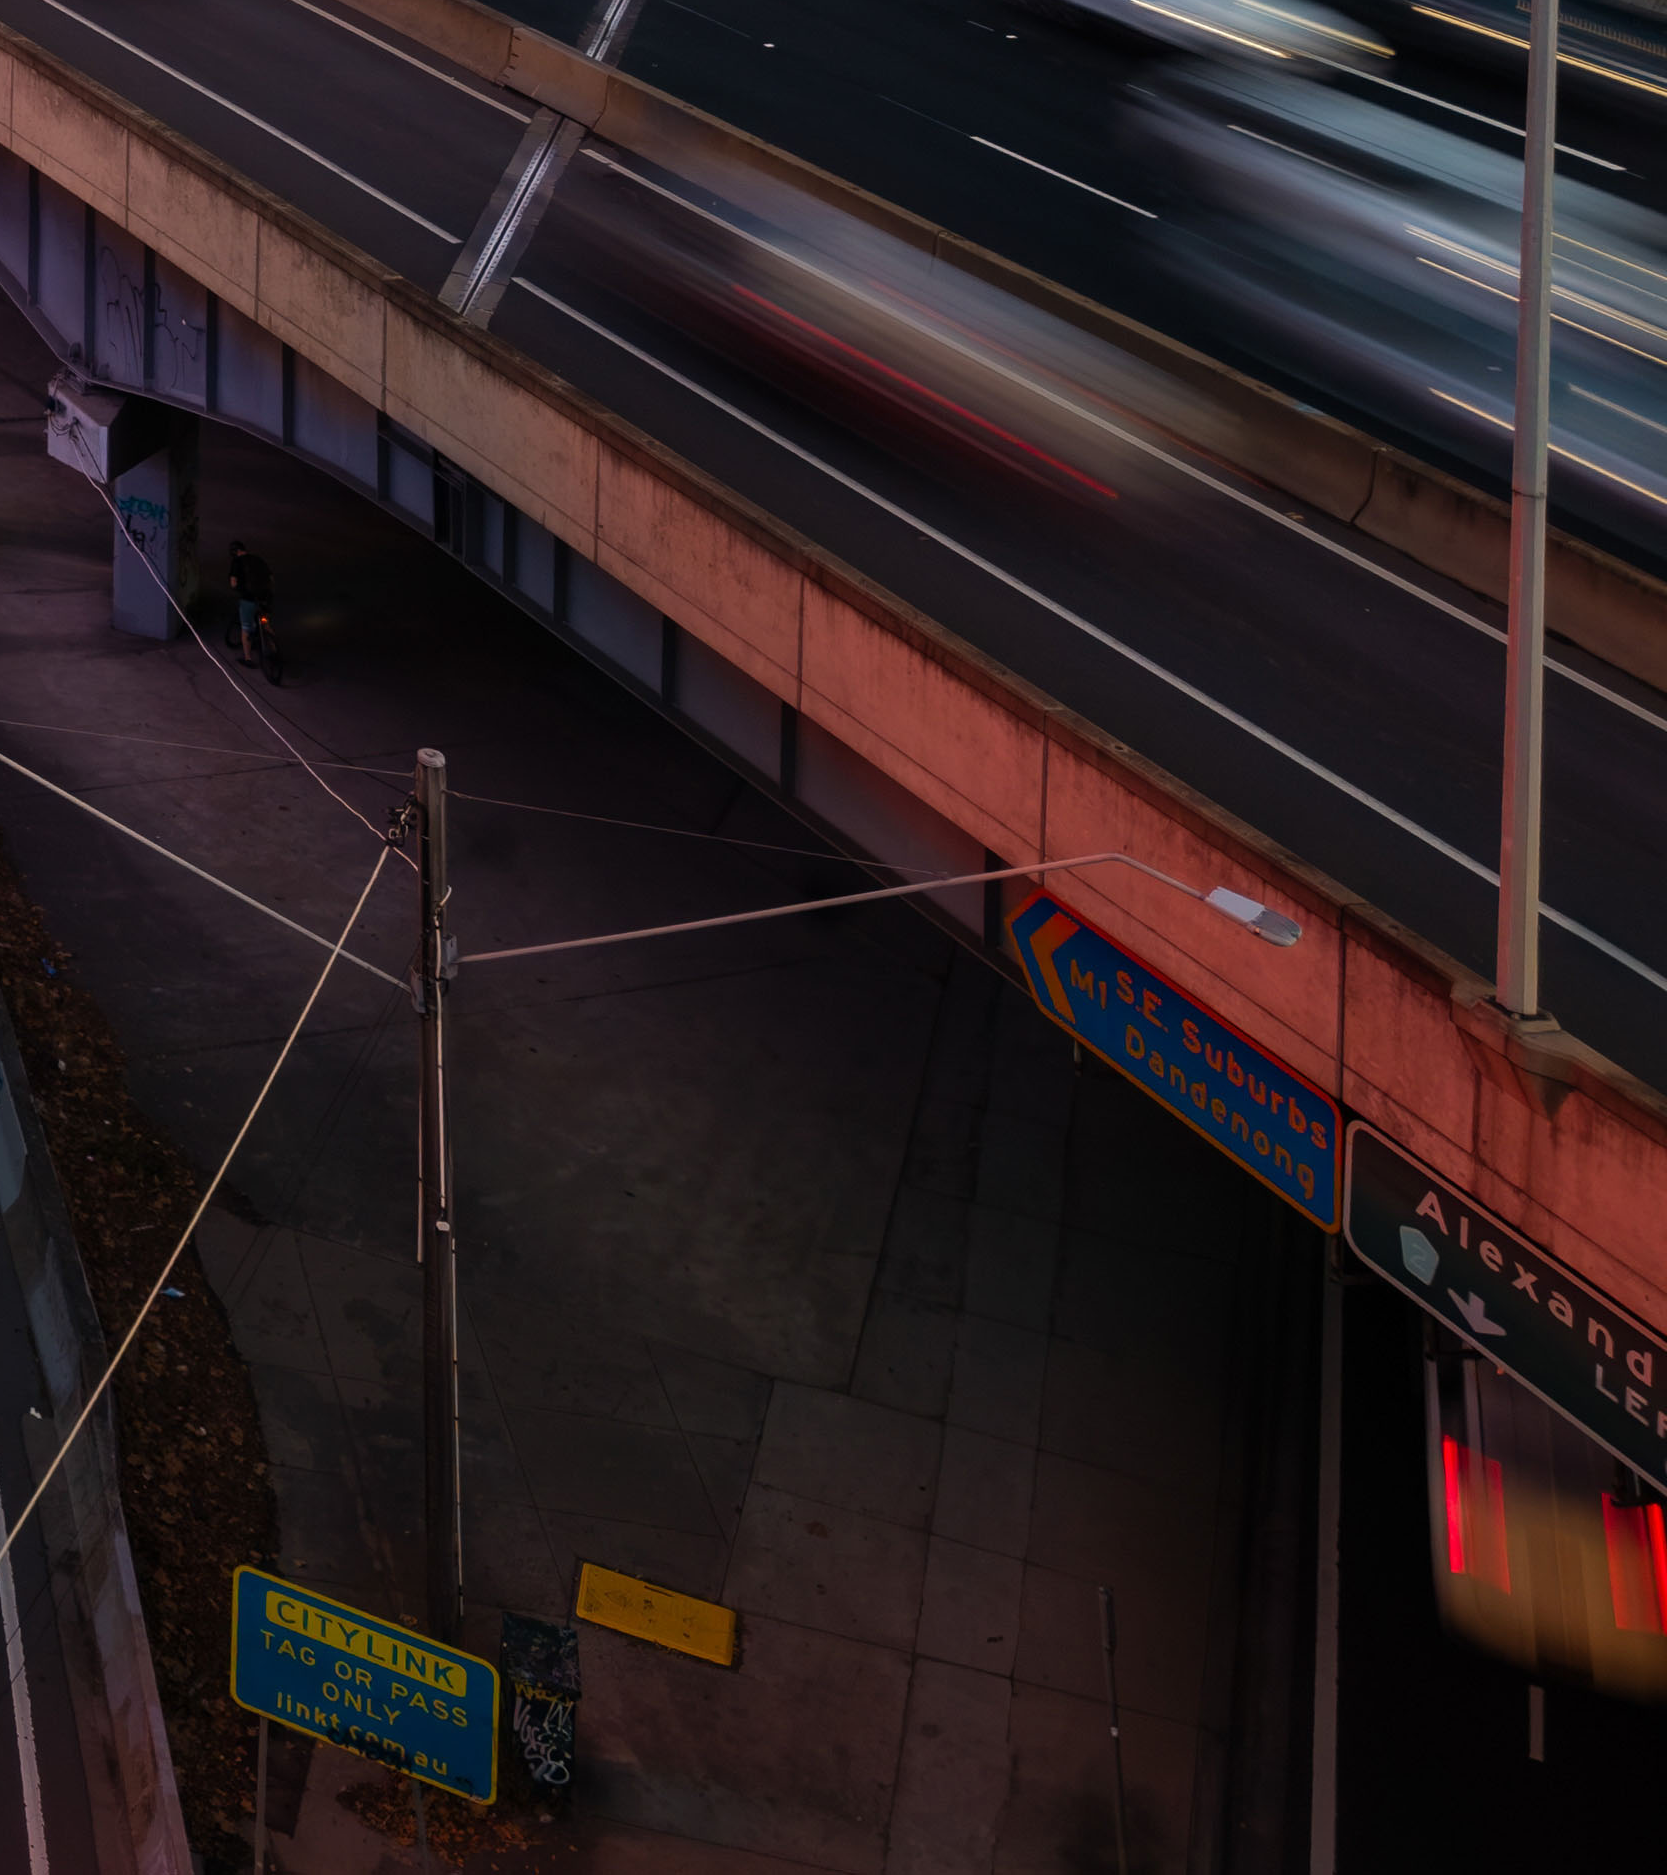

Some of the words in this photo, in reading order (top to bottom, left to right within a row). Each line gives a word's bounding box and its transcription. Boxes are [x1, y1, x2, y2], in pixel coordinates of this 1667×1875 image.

[1070, 957, 1108, 1010] M1
[1125, 1023, 1316, 1201] Dandenong
[1181, 1017, 1328, 1150] Suburbs
[1415, 1189, 1654, 1388] Alexand
[260, 1628, 317, 1667] TAG
[334, 1660, 373, 1690] OR
[390, 1681, 468, 1728] PASS
[276, 1600, 454, 1689] CITYLINK
[275, 1691, 449, 1776] linktcomau
[322, 1681, 402, 1726] ONLY
